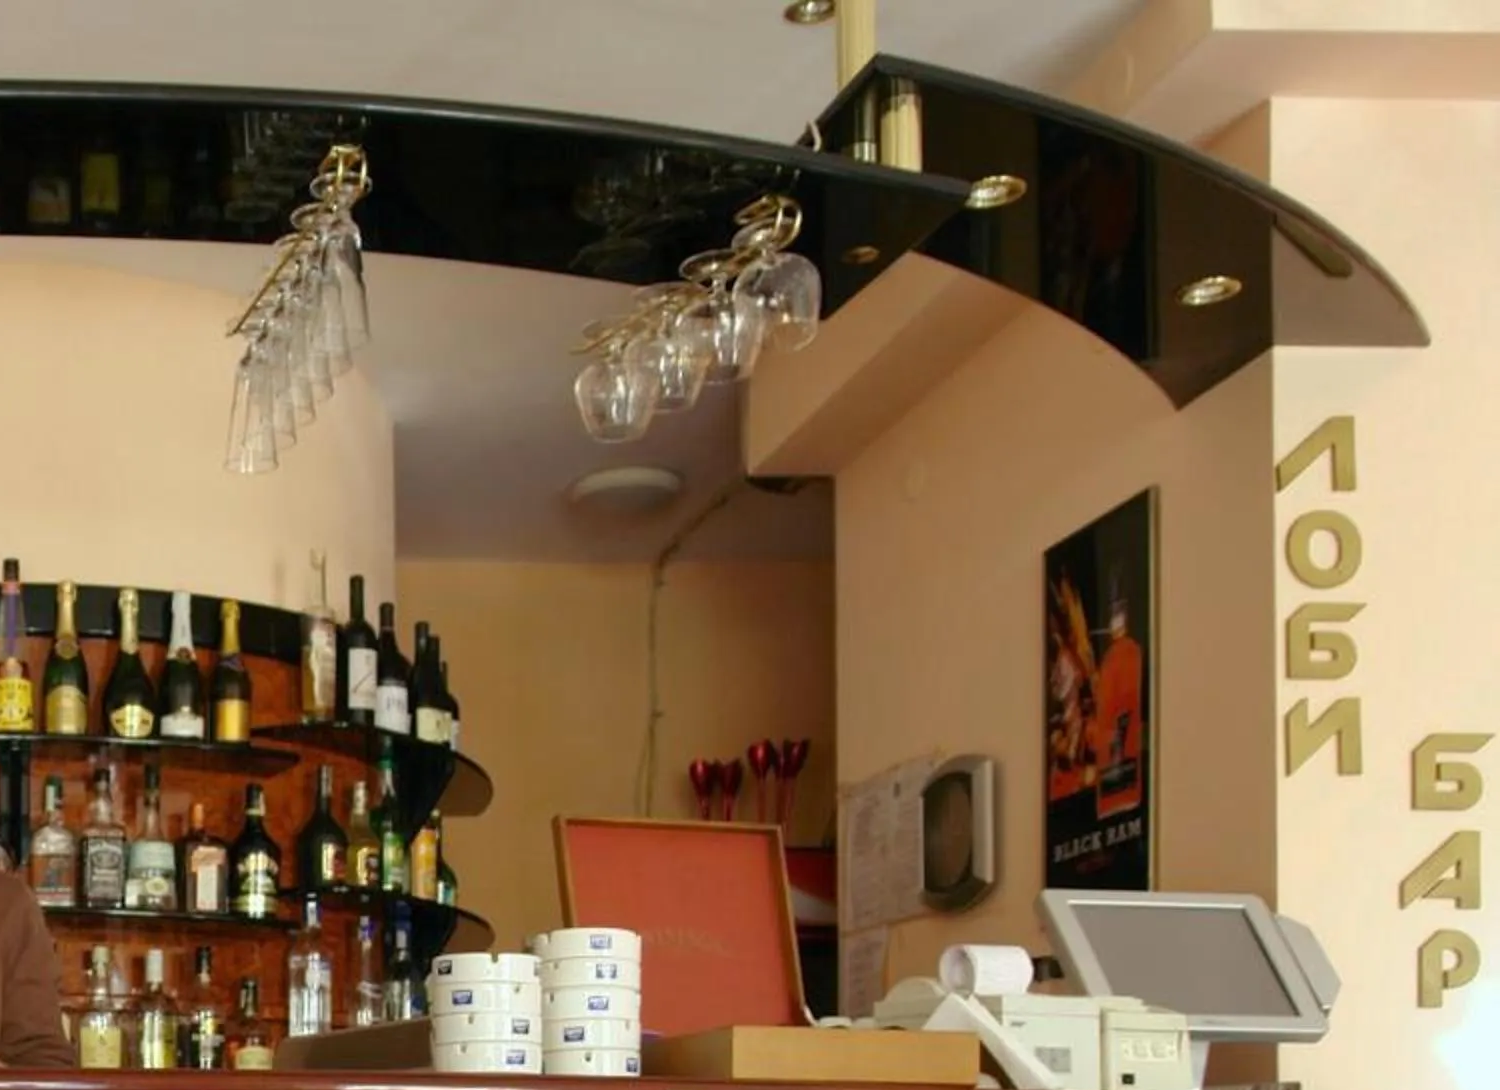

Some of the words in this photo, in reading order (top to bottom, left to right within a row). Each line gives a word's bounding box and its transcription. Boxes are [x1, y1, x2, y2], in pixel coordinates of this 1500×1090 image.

[1276, 415, 1367, 777] ЛОБИ
[1053, 831, 1102, 863] BLACK
[1106, 816, 1142, 847] RAM
[1398, 732, 1496, 1009] БАР
